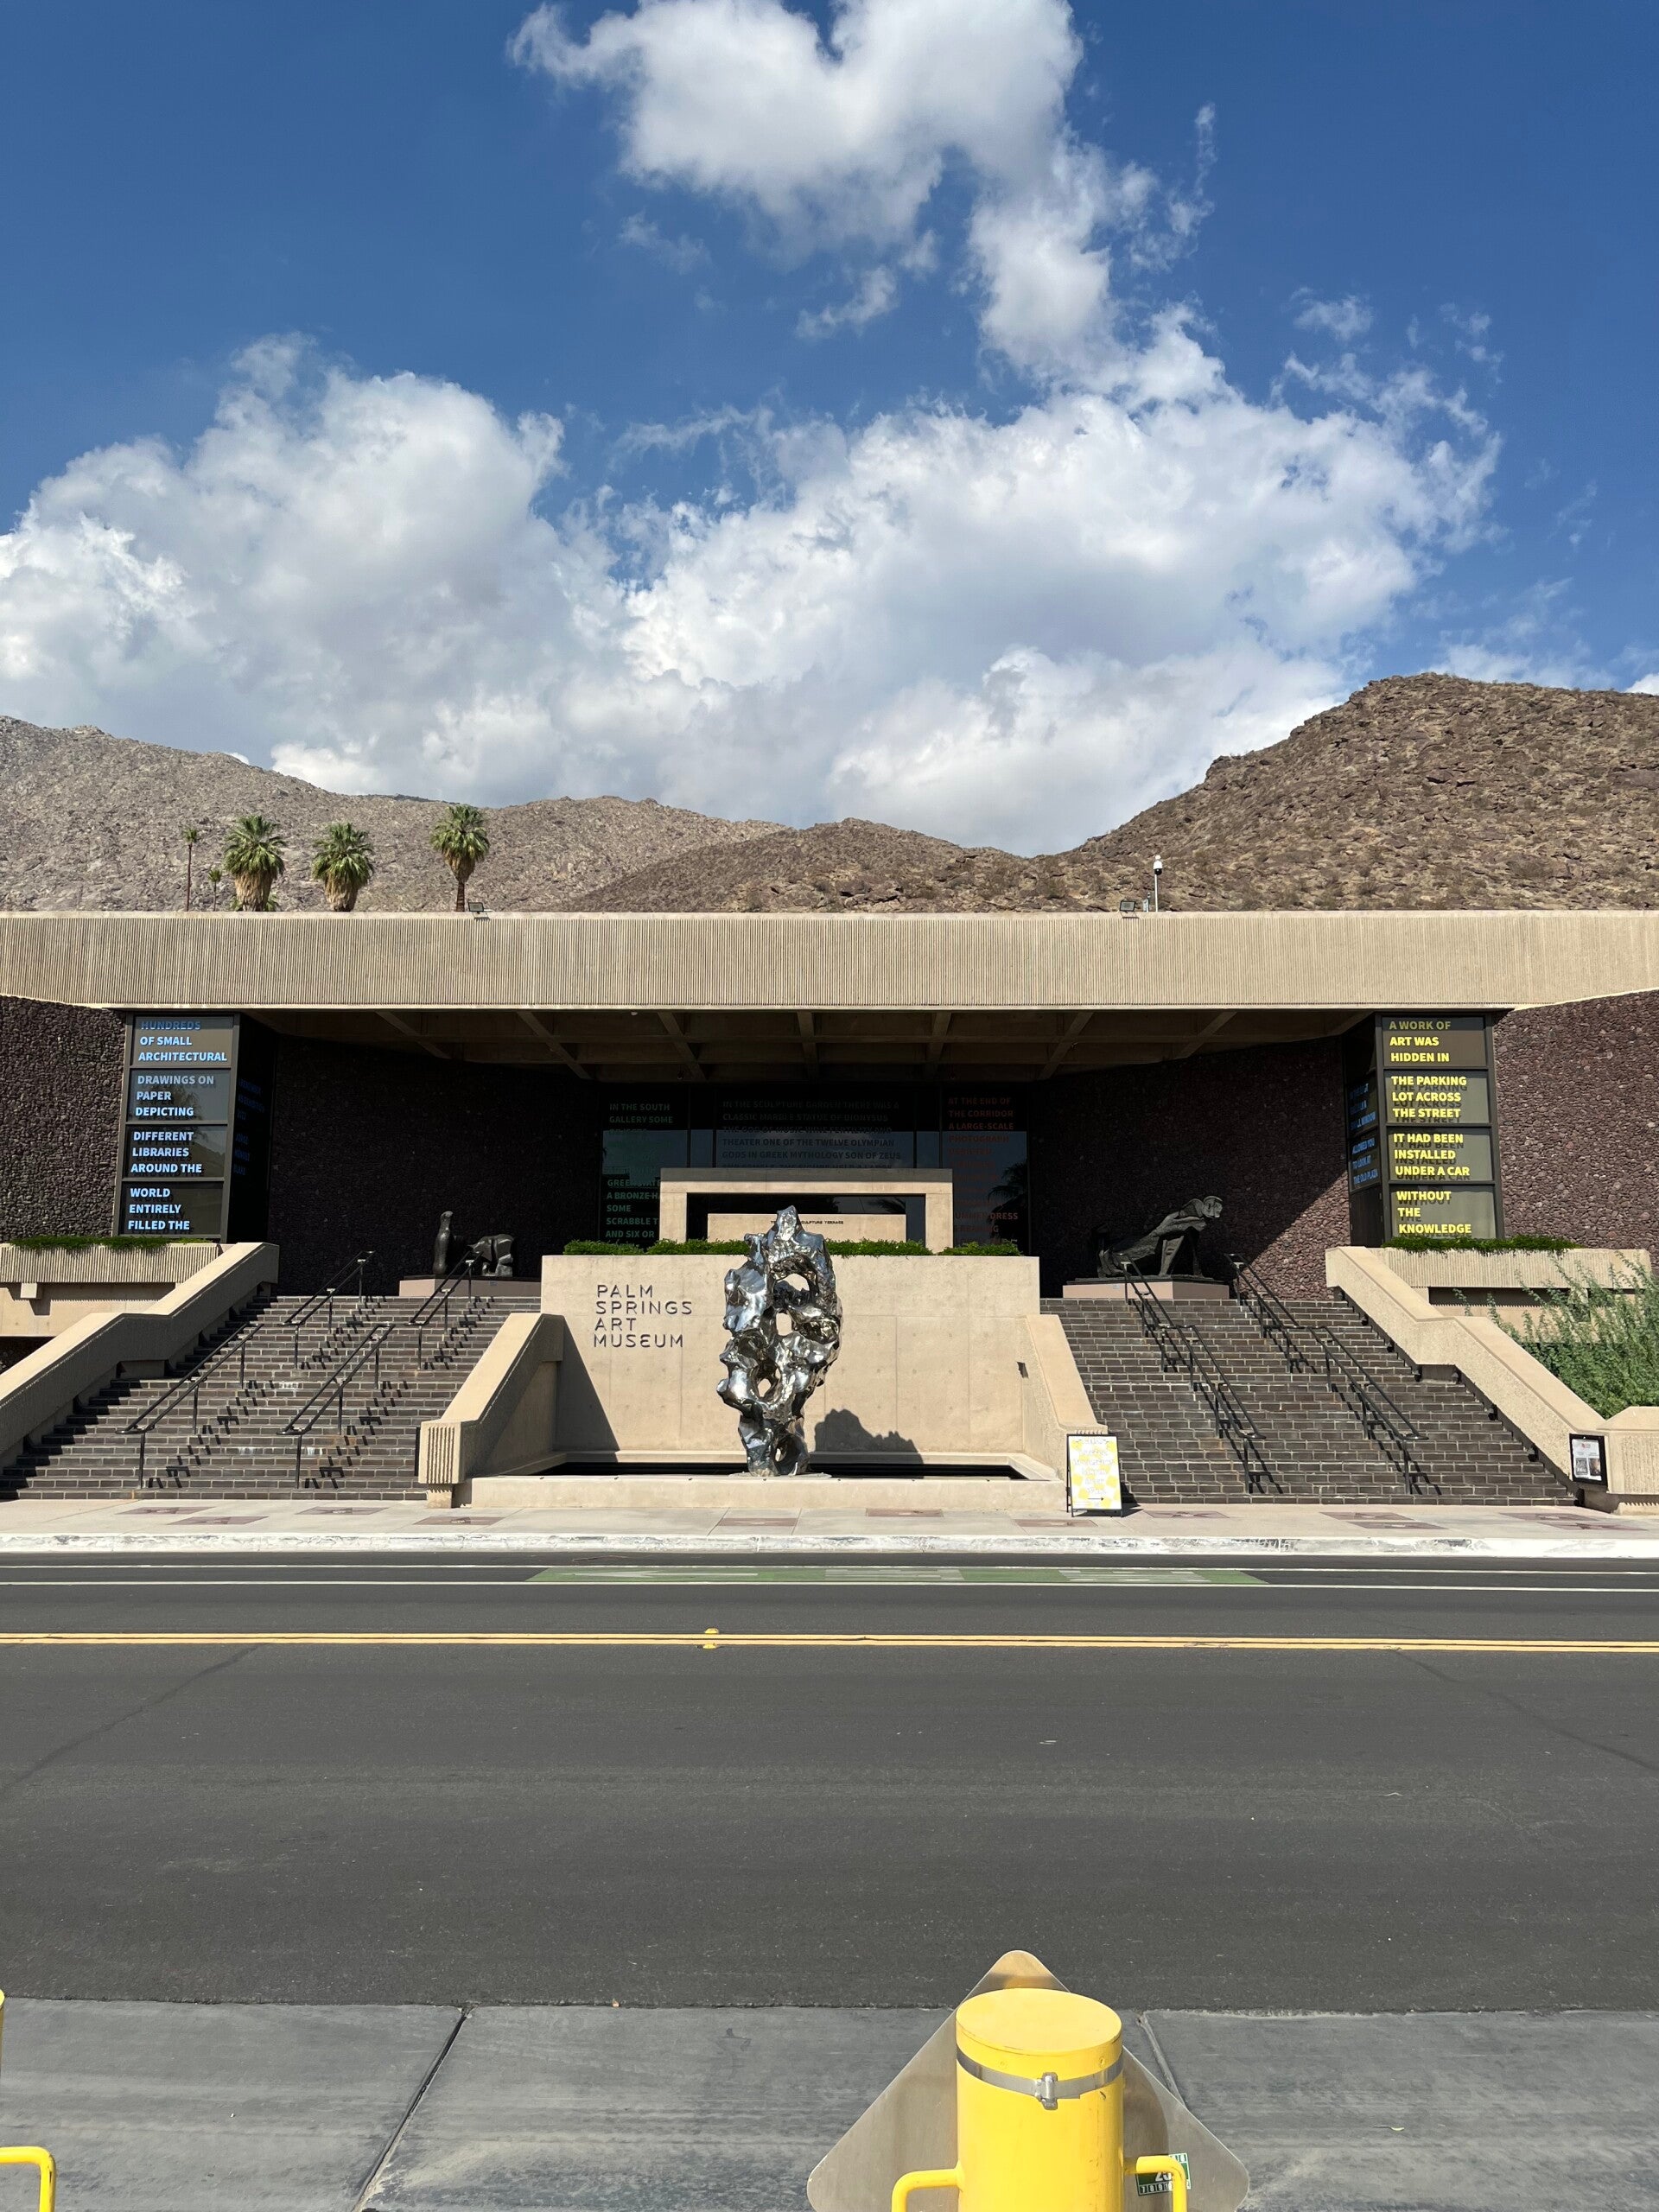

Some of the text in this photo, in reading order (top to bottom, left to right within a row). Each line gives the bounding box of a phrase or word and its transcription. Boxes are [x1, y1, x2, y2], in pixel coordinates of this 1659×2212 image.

[141, 1020, 201, 1030] HUNDREDS
[1389, 1021, 1452, 1030] A WORK OF
[139, 1036, 193, 1046] OF SMALL
[1389, 1037, 1440, 1046] ART WAS
[138, 1052, 227, 1061] ARCHITECTURAL
[1390, 1052, 1450, 1062] HIDDEN IN
[137, 1075, 214, 1084] DRAWINGS ON
[1391, 1076, 1467, 1085] THE PARKING
[136, 1091, 172, 1100] PAPER
[1392, 1092, 1461, 1102] LOT ACROSS
[135, 1107, 194, 1116] DEPICTING
[1392, 1109, 1461, 1118] THE STREET
[133, 1131, 194, 1141] DIFFERENT
[1393, 1134, 1464, 1143] IT HAD BEEN
[722, 1138, 894, 1147] THEATER ONE OF THE TWELVE OLYMPIAN
[132, 1147, 189, 1157] LIBRARIES
[722, 1151, 901, 1160] GODS IN GREEK MYTHOLOGY SON OF ZEUS
[1394, 1150, 1456, 1160] INSTALLED
[130, 1163, 202, 1173] AROUND THE
[1395, 1166, 1470, 1176] UNDER A CAR
[130, 1188, 170, 1198] WORLD
[1396, 1191, 1452, 1200] WITHOUT
[129, 1204, 181, 1213] ENTIRELY
[1397, 1207, 1421, 1217] THE
[128, 1221, 190, 1230] FILLED THE
[1399, 1224, 1471, 1234] KNOWLEDGE
[597, 1284, 653, 1298] PALM
[595, 1300, 692, 1314] SPRINGS
[594, 1317, 637, 1331] ART
[594, 1333, 683, 1348] MUSEUM
